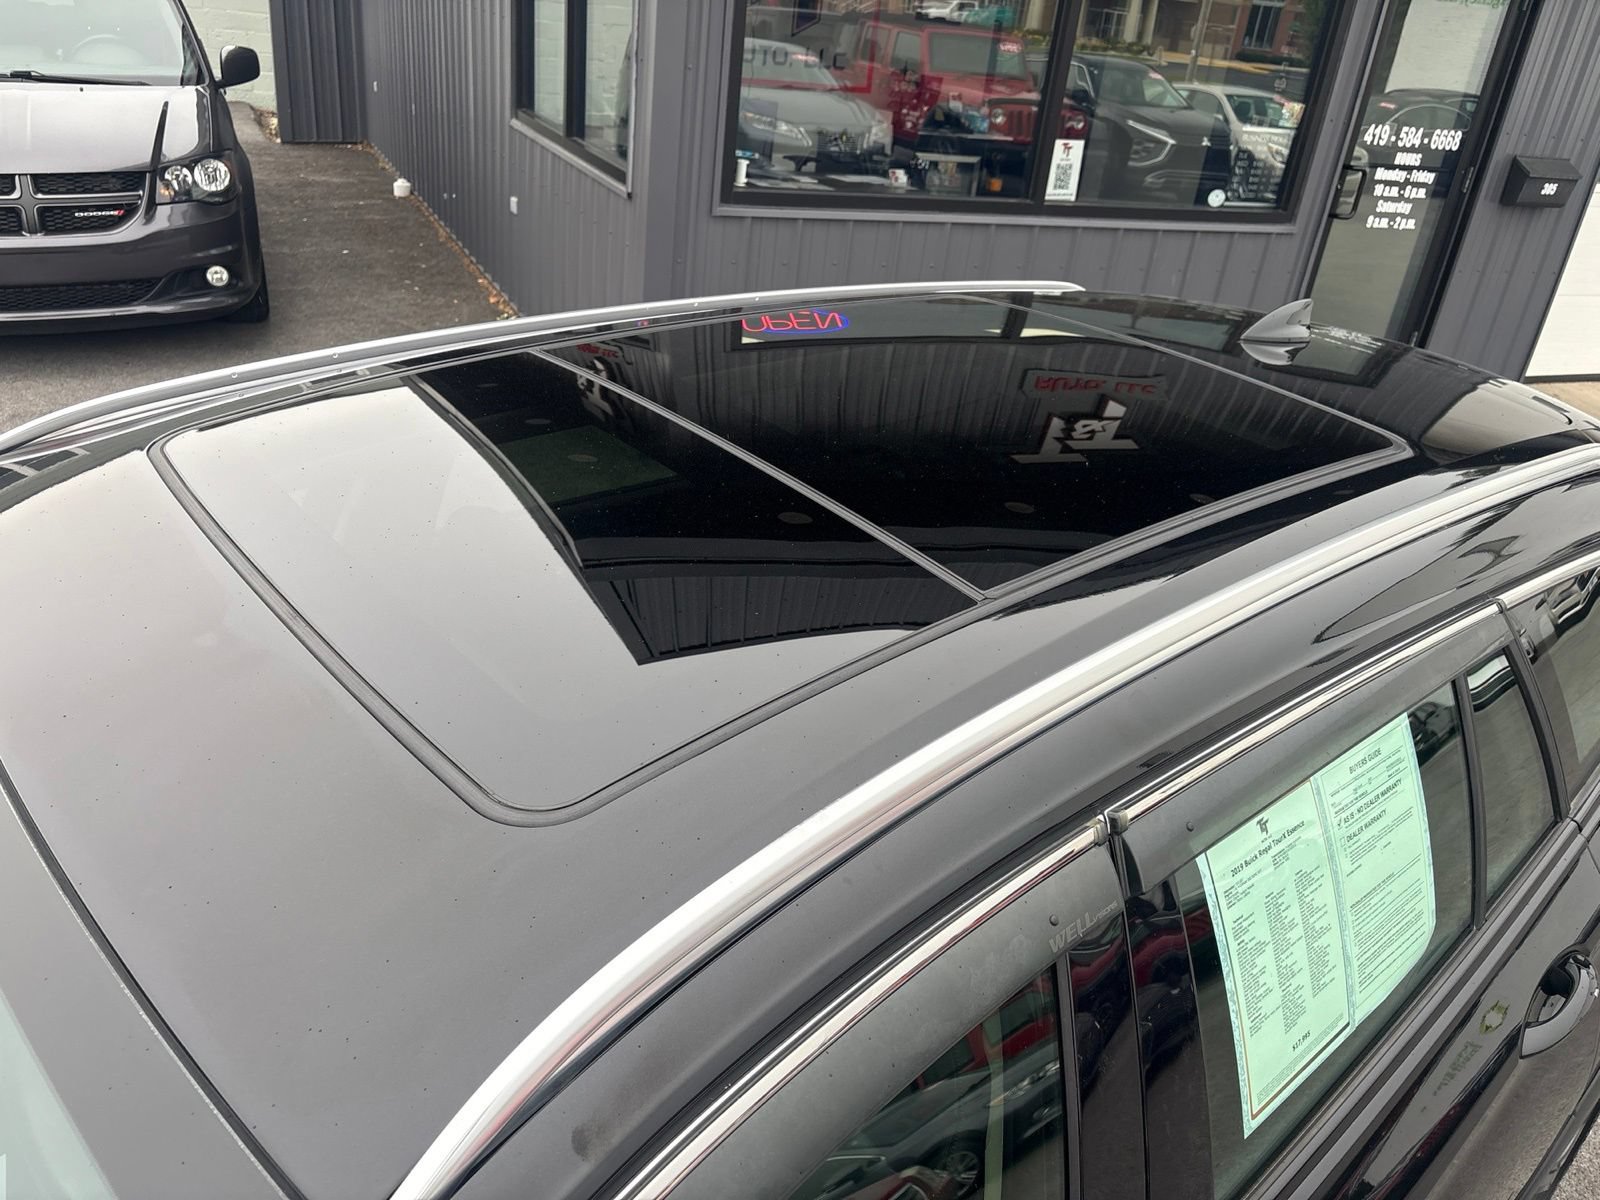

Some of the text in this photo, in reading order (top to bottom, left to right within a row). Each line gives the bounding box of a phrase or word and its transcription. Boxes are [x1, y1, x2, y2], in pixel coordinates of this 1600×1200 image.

[1363, 123, 1390, 146] 419
[1397, 126, 1424, 148] 584
[1430, 128, 1462, 151] 6668
[1394, 152, 1422, 166] HOURS
[1374, 167, 1407, 183] Monday
[1410, 169, 1436, 184] Friday
[1373, 183, 1384, 197] 10
[1403, 185, 1412, 198] 6
[1376, 200, 1413, 215] Saturday
[1366, 215, 1374, 228] 9
[1393, 216, 1401, 229] 2
[1367, 747, 1381, 762] GUIDE
[1363, 793, 1380, 810] DEALER
[1379, 777, 1401, 798] WARRANTY
[1346, 825, 1365, 842] DEALER
[1364, 808, 1387, 829] WARRANTY
[1230, 862, 1244, 878] 2019
[1244, 854, 1258, 868] Buick
[1258, 841, 1273, 857] Regal
[1286, 820, 1305, 837] Essence
